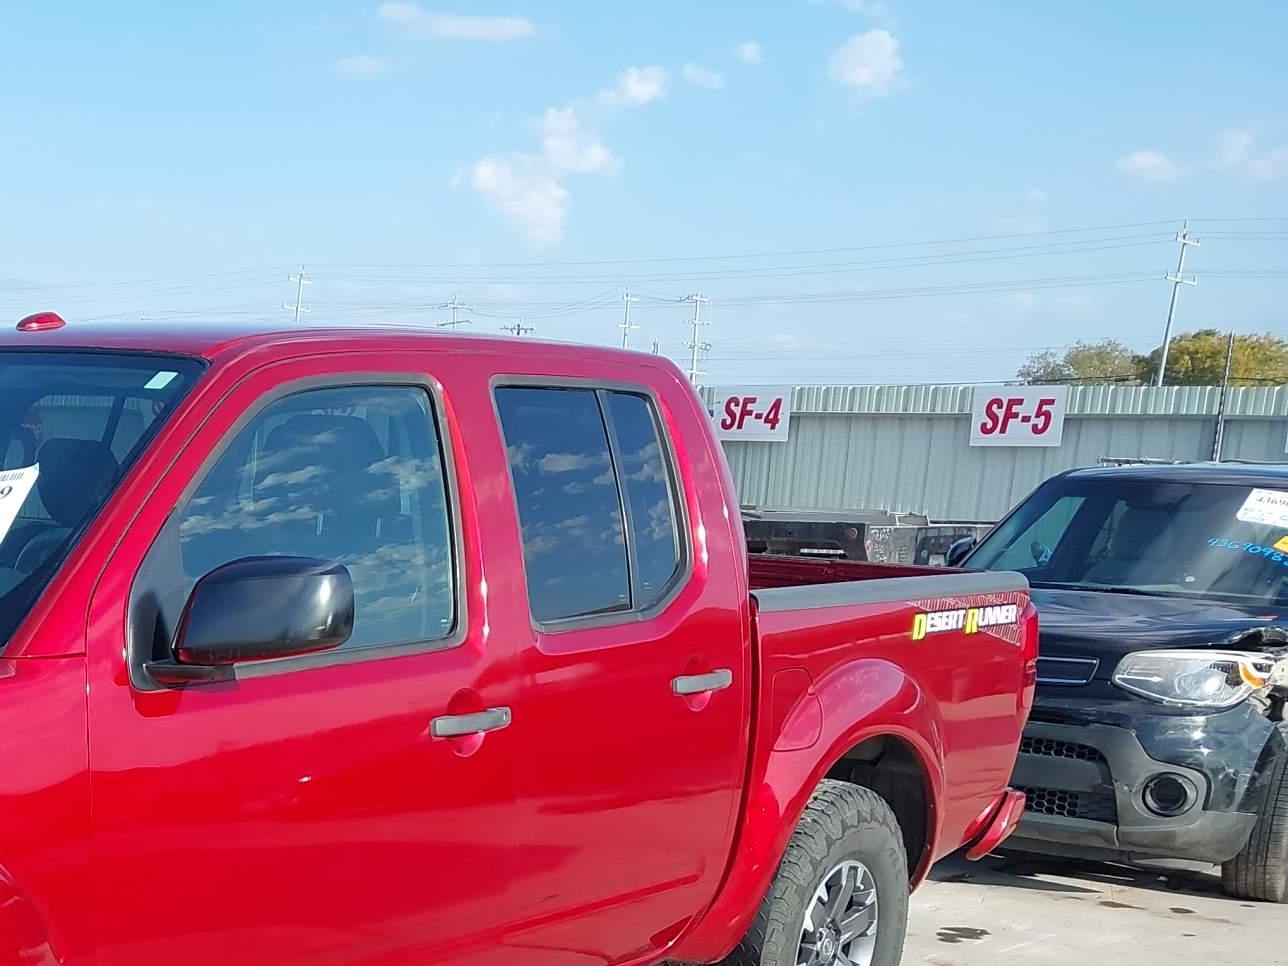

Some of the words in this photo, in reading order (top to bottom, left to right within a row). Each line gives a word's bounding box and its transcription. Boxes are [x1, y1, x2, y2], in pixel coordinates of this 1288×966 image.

[720, 397, 782, 431] SF-4
[980, 398, 1056, 435] SF-5
[912, 608, 967, 641] DESERT
[964, 602, 1017, 634] RUNNER
